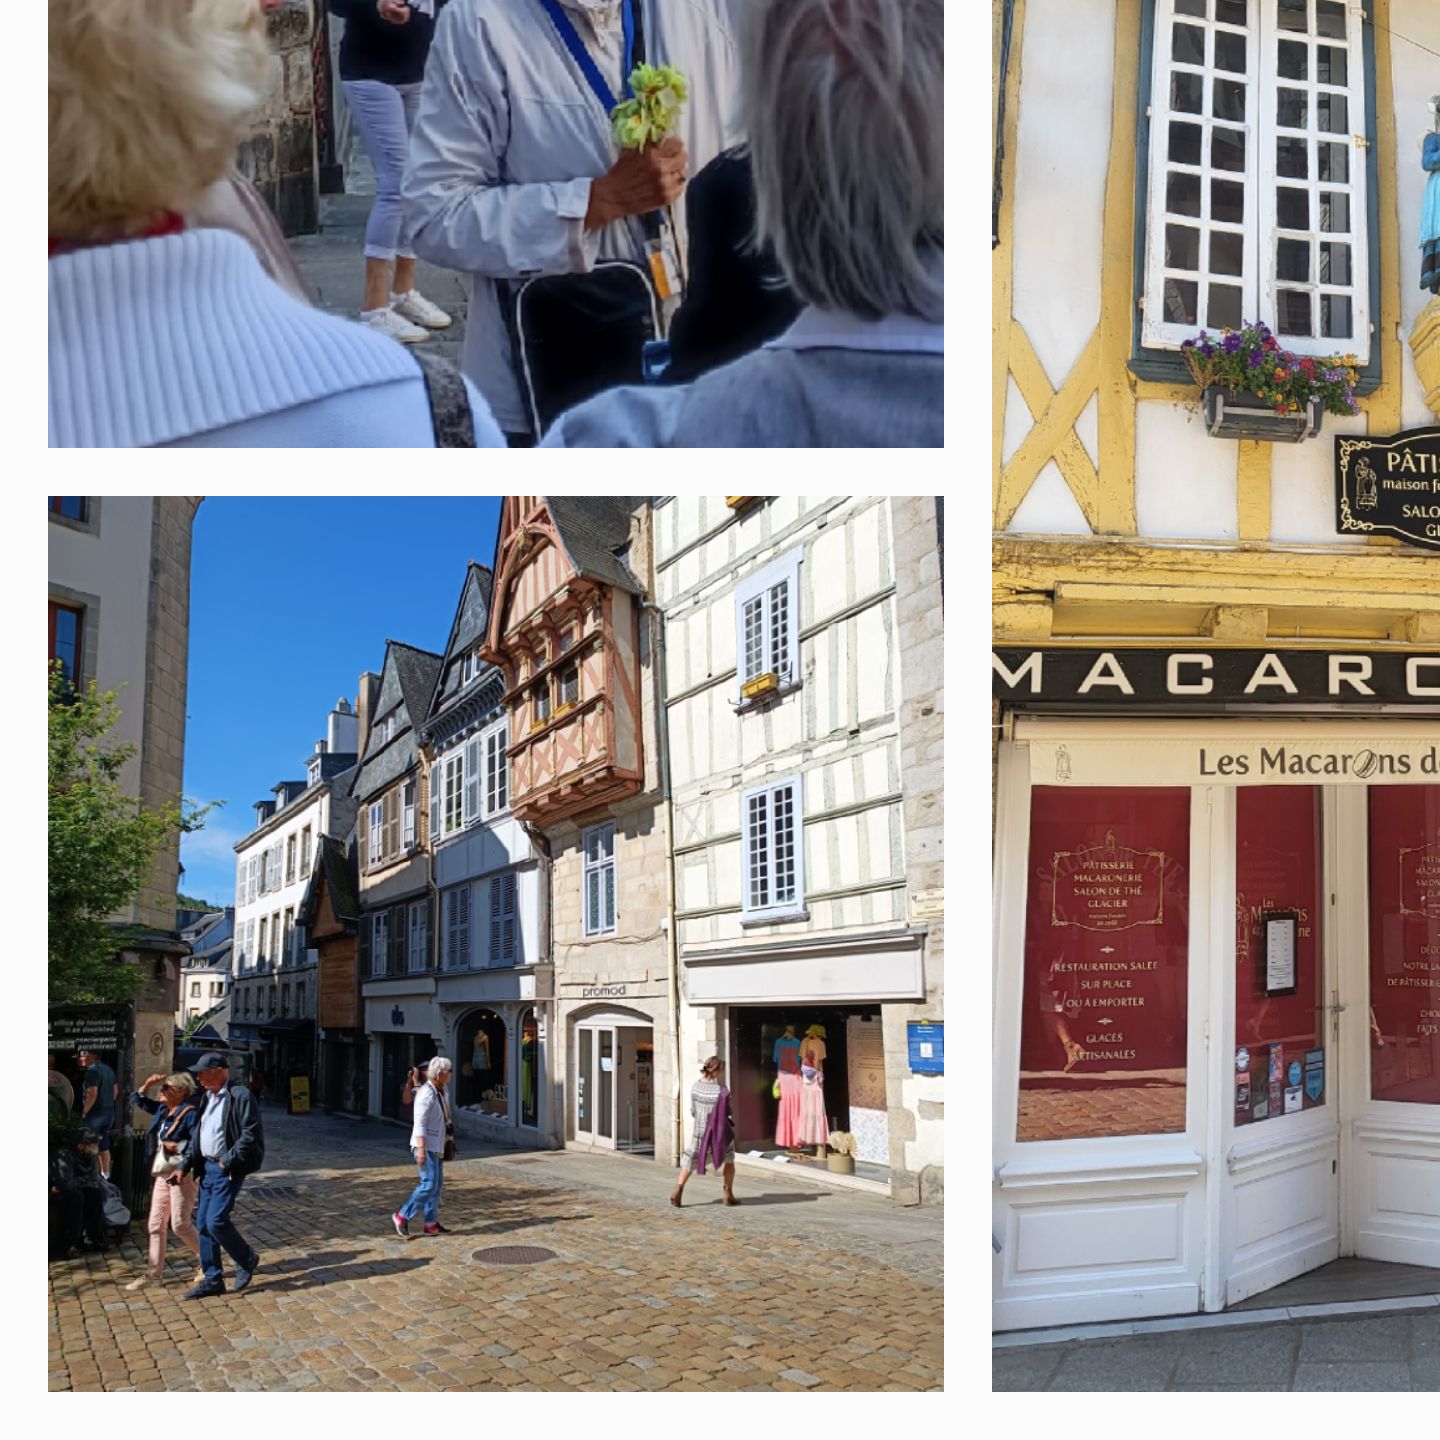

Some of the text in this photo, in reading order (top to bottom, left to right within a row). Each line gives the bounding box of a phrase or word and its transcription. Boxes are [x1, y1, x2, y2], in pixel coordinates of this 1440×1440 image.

[1383, 479, 1429, 491] maison
[1200, 748, 1249, 776] Les
[1074, 874, 1143, 883] MACARONERIE
[1073, 887, 1106, 896] SALON
[1109, 887, 1121, 896] DE
[1088, 900, 1128, 908] GLACIER
[1263, 898, 1274, 907] Les
[1055, 963, 1128, 972] RESTAURATION
[1081, 980, 1133, 989] SUR PLACE
[583, 985, 626, 998] promod
[1067, 1000, 1081, 1008] OU
[1093, 997, 1144, 1007] EMPORTER
[1073, 1050, 1136, 1061] ARTISANALES
